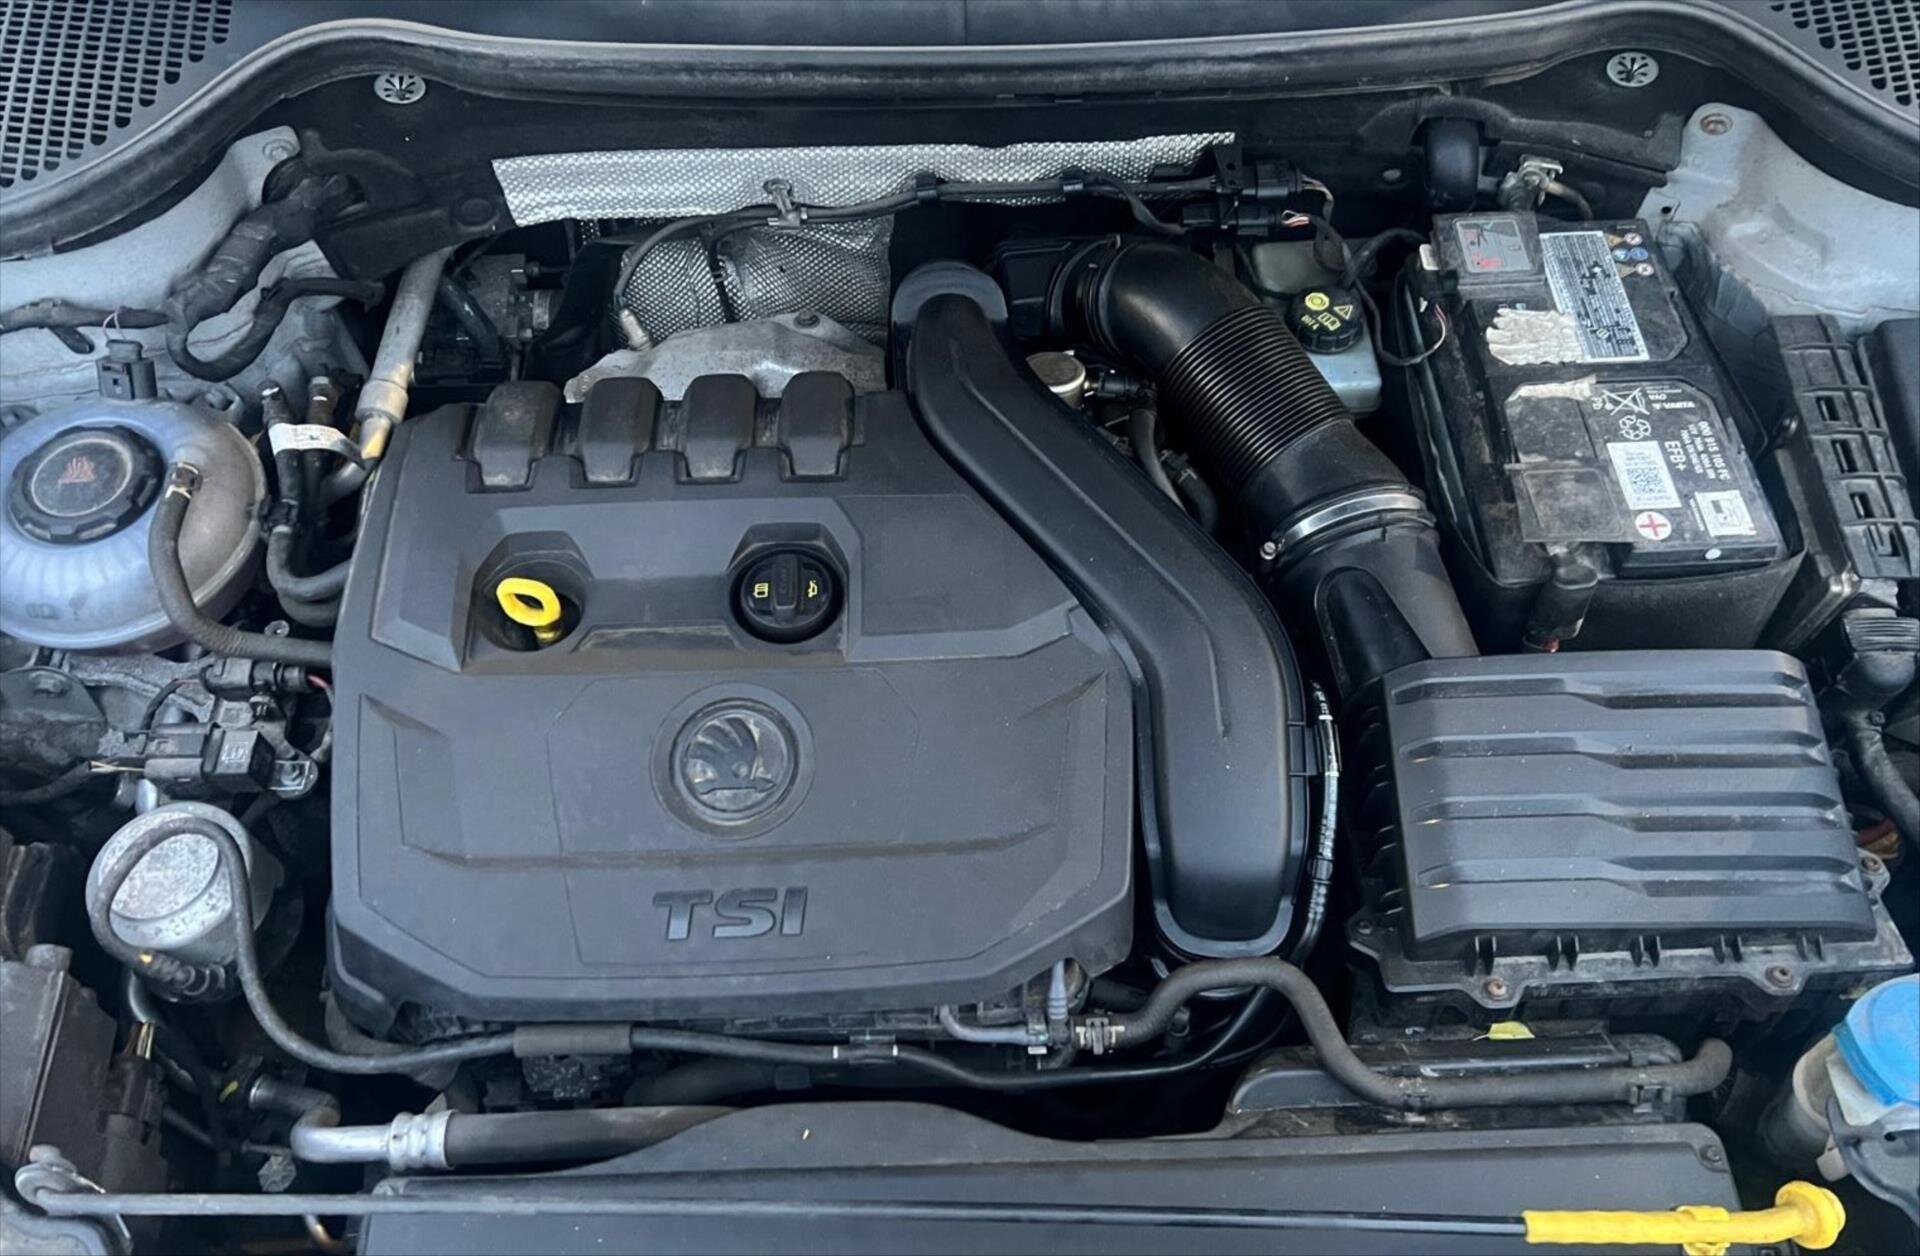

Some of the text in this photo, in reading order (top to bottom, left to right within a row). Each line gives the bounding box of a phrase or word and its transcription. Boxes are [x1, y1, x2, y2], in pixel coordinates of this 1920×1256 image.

[1662, 401, 1695, 409] VARTA
[1664, 441, 1687, 471] EFB+
[652, 886, 808, 940] TSI
